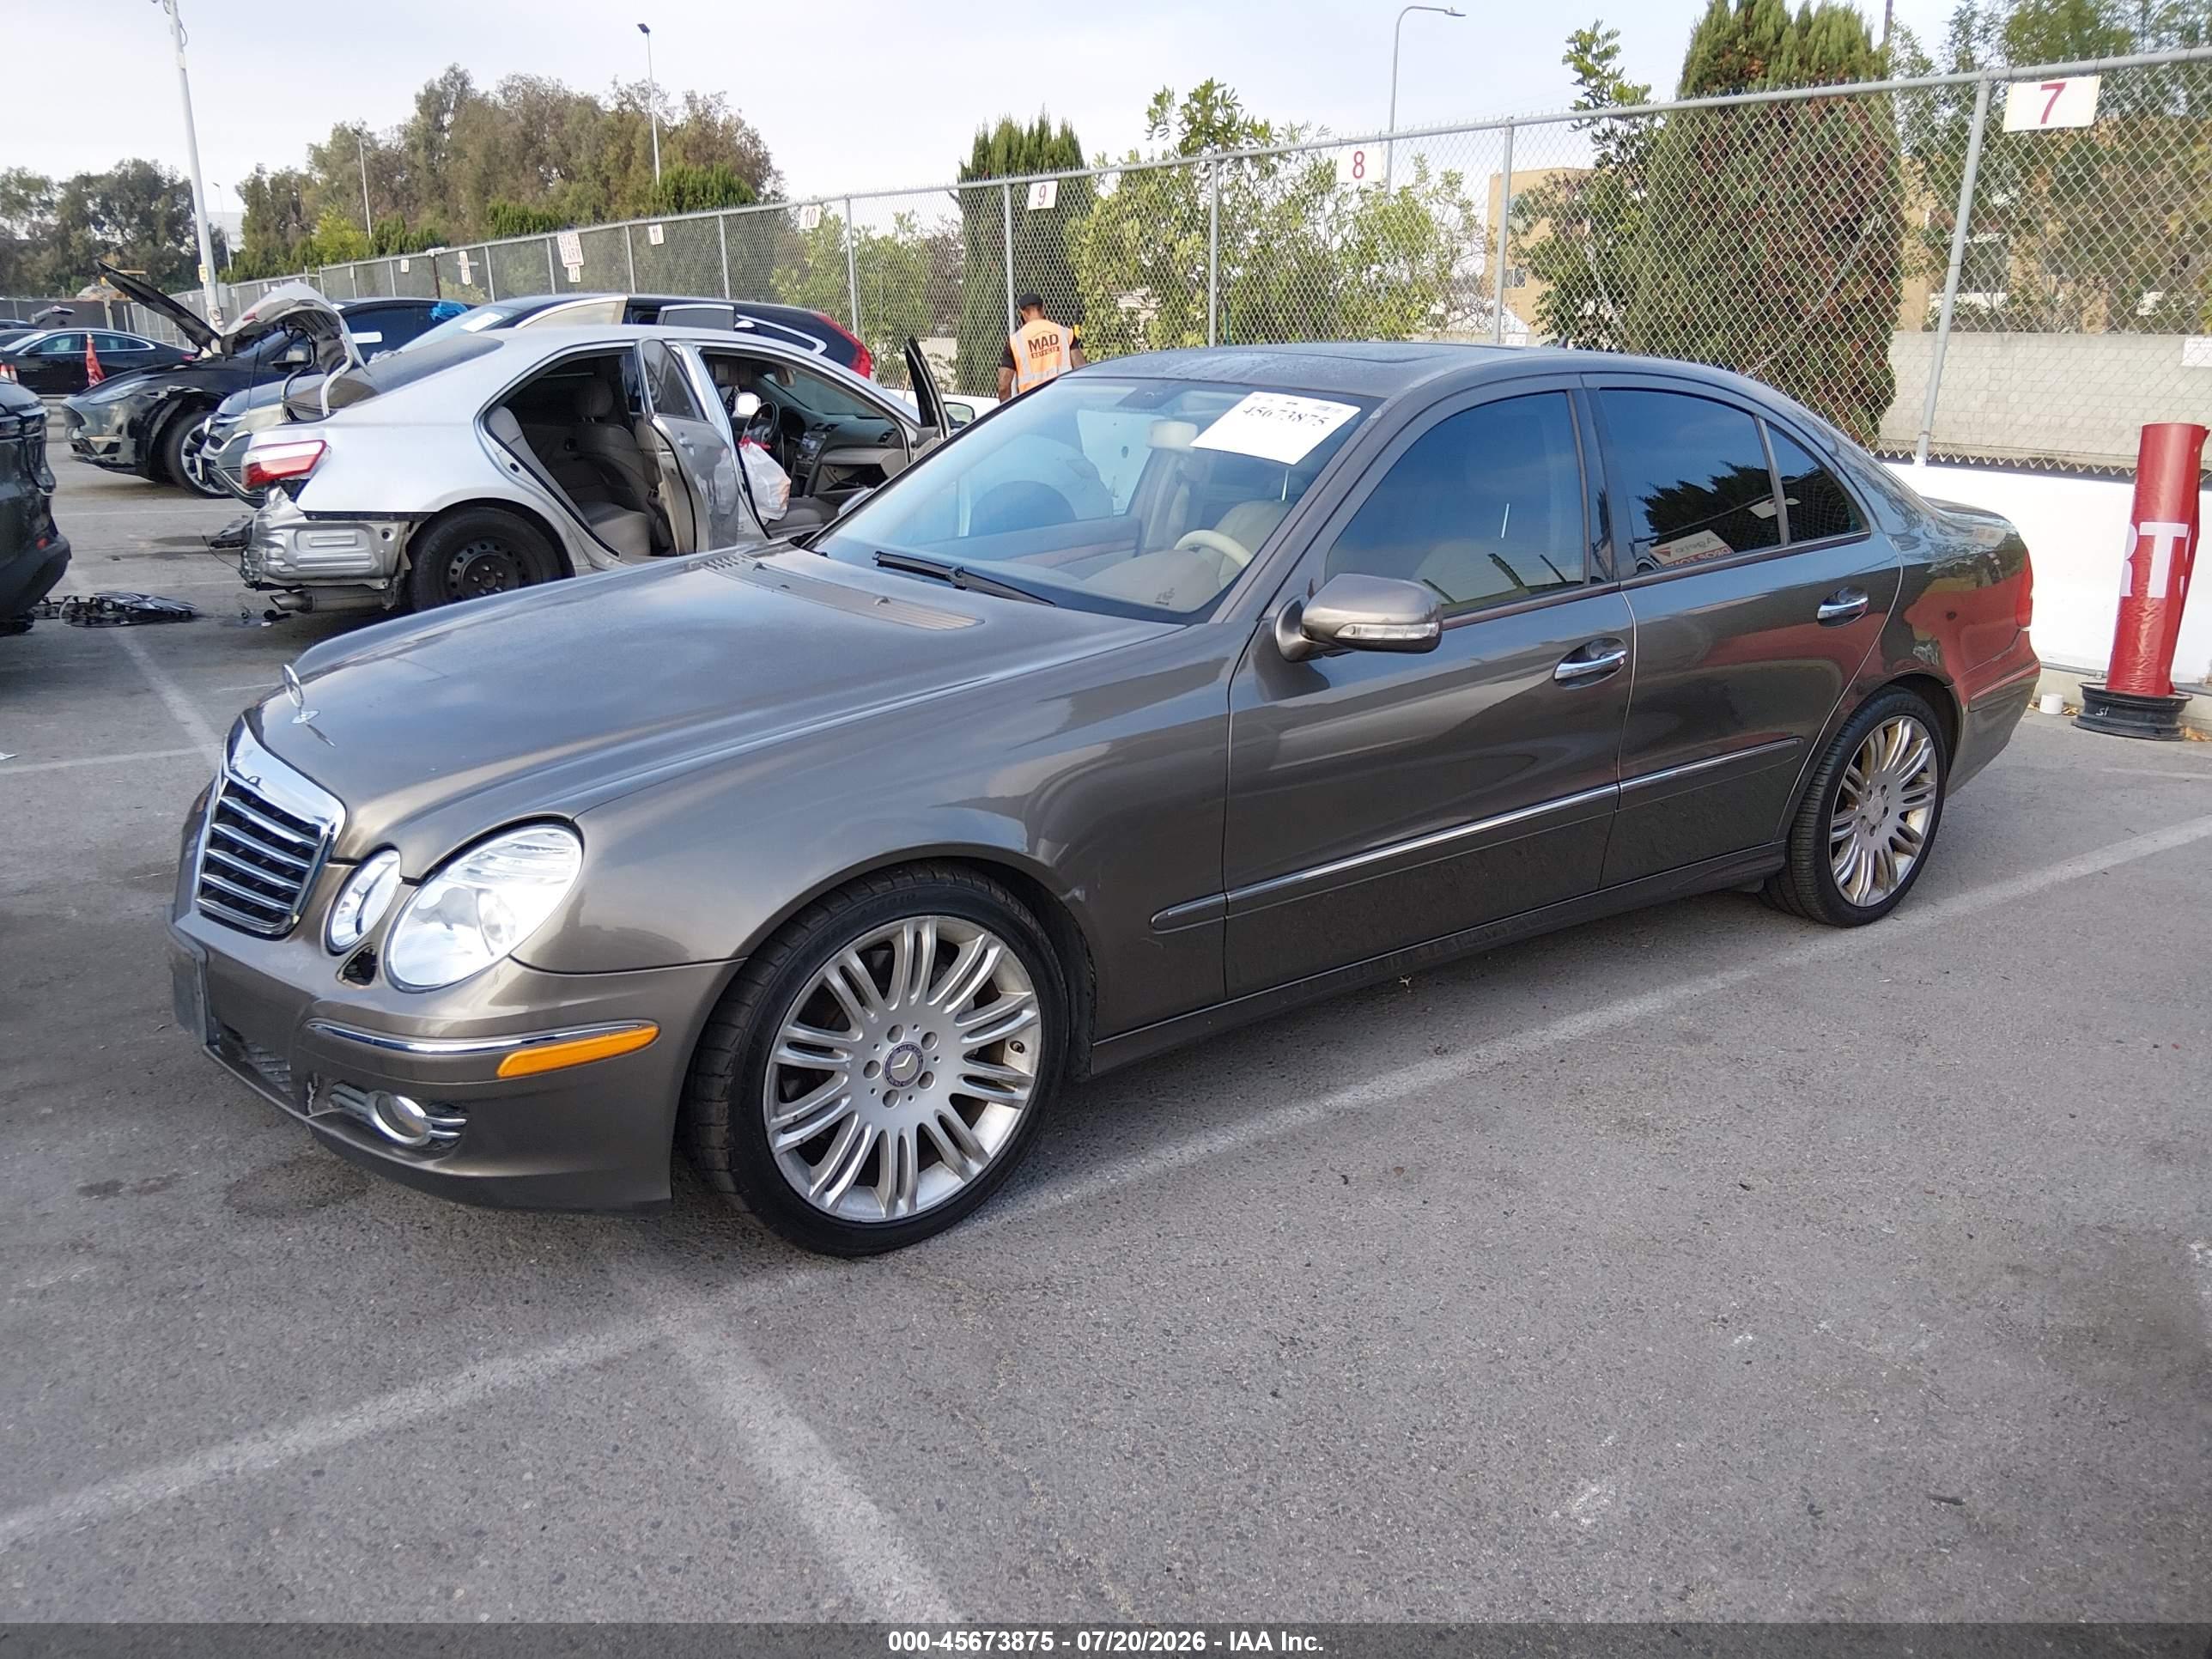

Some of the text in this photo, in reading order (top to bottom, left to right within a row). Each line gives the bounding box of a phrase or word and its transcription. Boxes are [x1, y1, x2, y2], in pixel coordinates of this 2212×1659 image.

[2040, 82, 2067, 125] 7
[1352, 150, 1365, 179] 8
[1037, 184, 1047, 207] 9
[805, 208, 817, 228] 10
[1028, 333, 1060, 354] MAD
